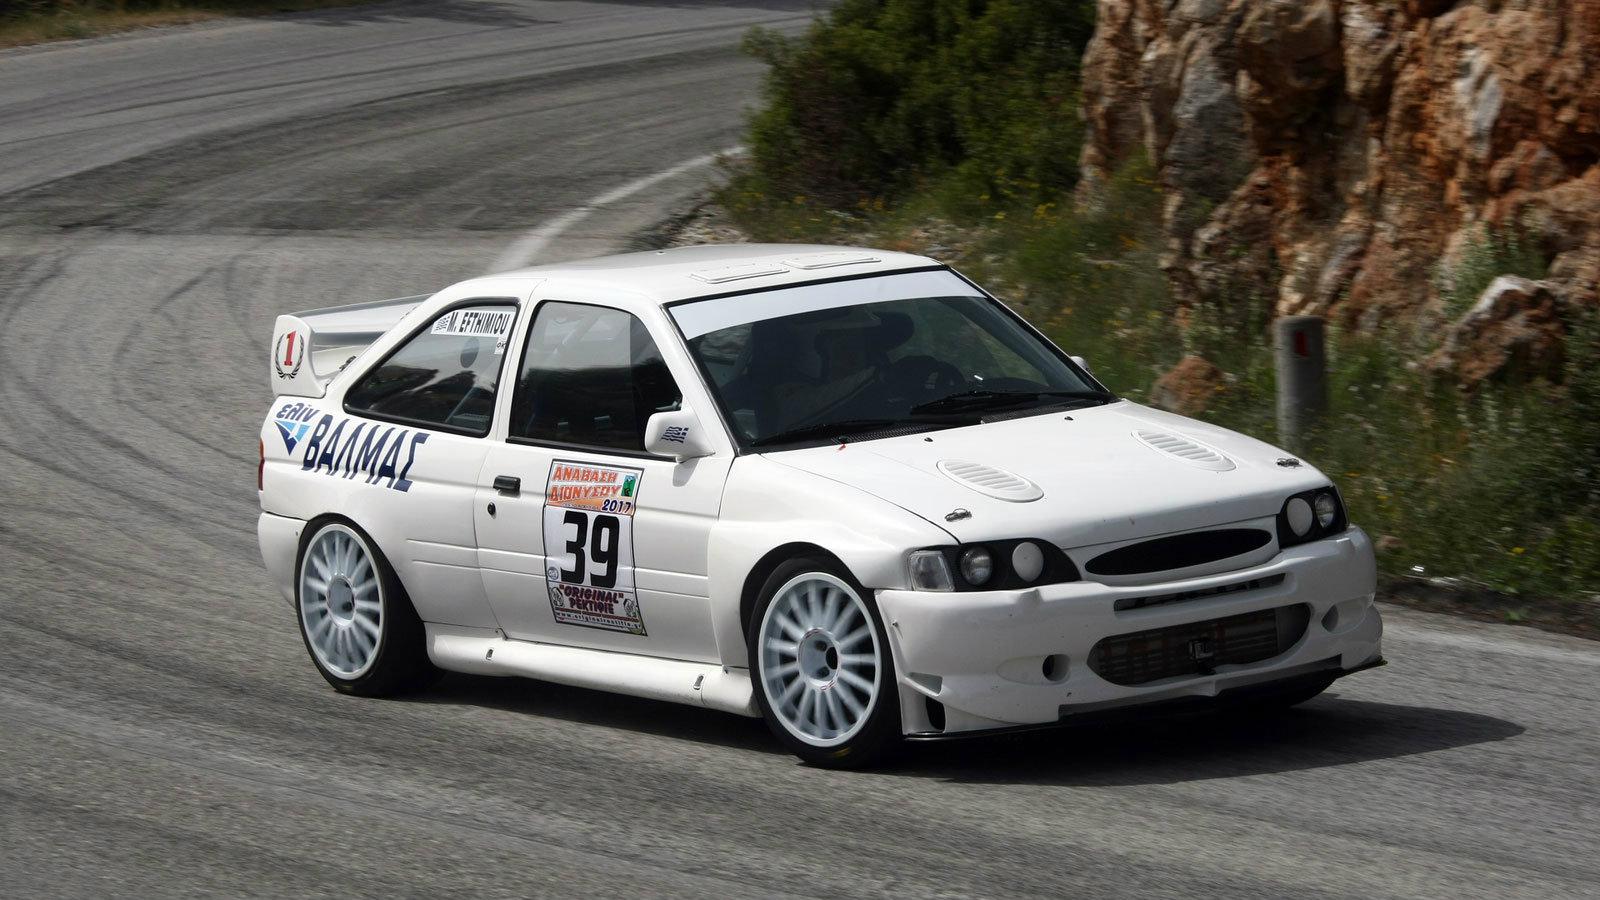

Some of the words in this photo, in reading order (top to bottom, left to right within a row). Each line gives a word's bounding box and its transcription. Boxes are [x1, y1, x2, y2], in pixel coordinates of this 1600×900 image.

[459, 312, 511, 335] EFTHIMIOU
[284, 331, 297, 366] 1
[301, 414, 431, 493] ΒΑΛΜΑΣ
[553, 465, 618, 483] ΑΝΑΒΑΣΗ
[549, 485, 622, 502] ΔΙΟΝΥΣΟΥ
[601, 499, 632, 514] 2017
[560, 510, 620, 589] 39
